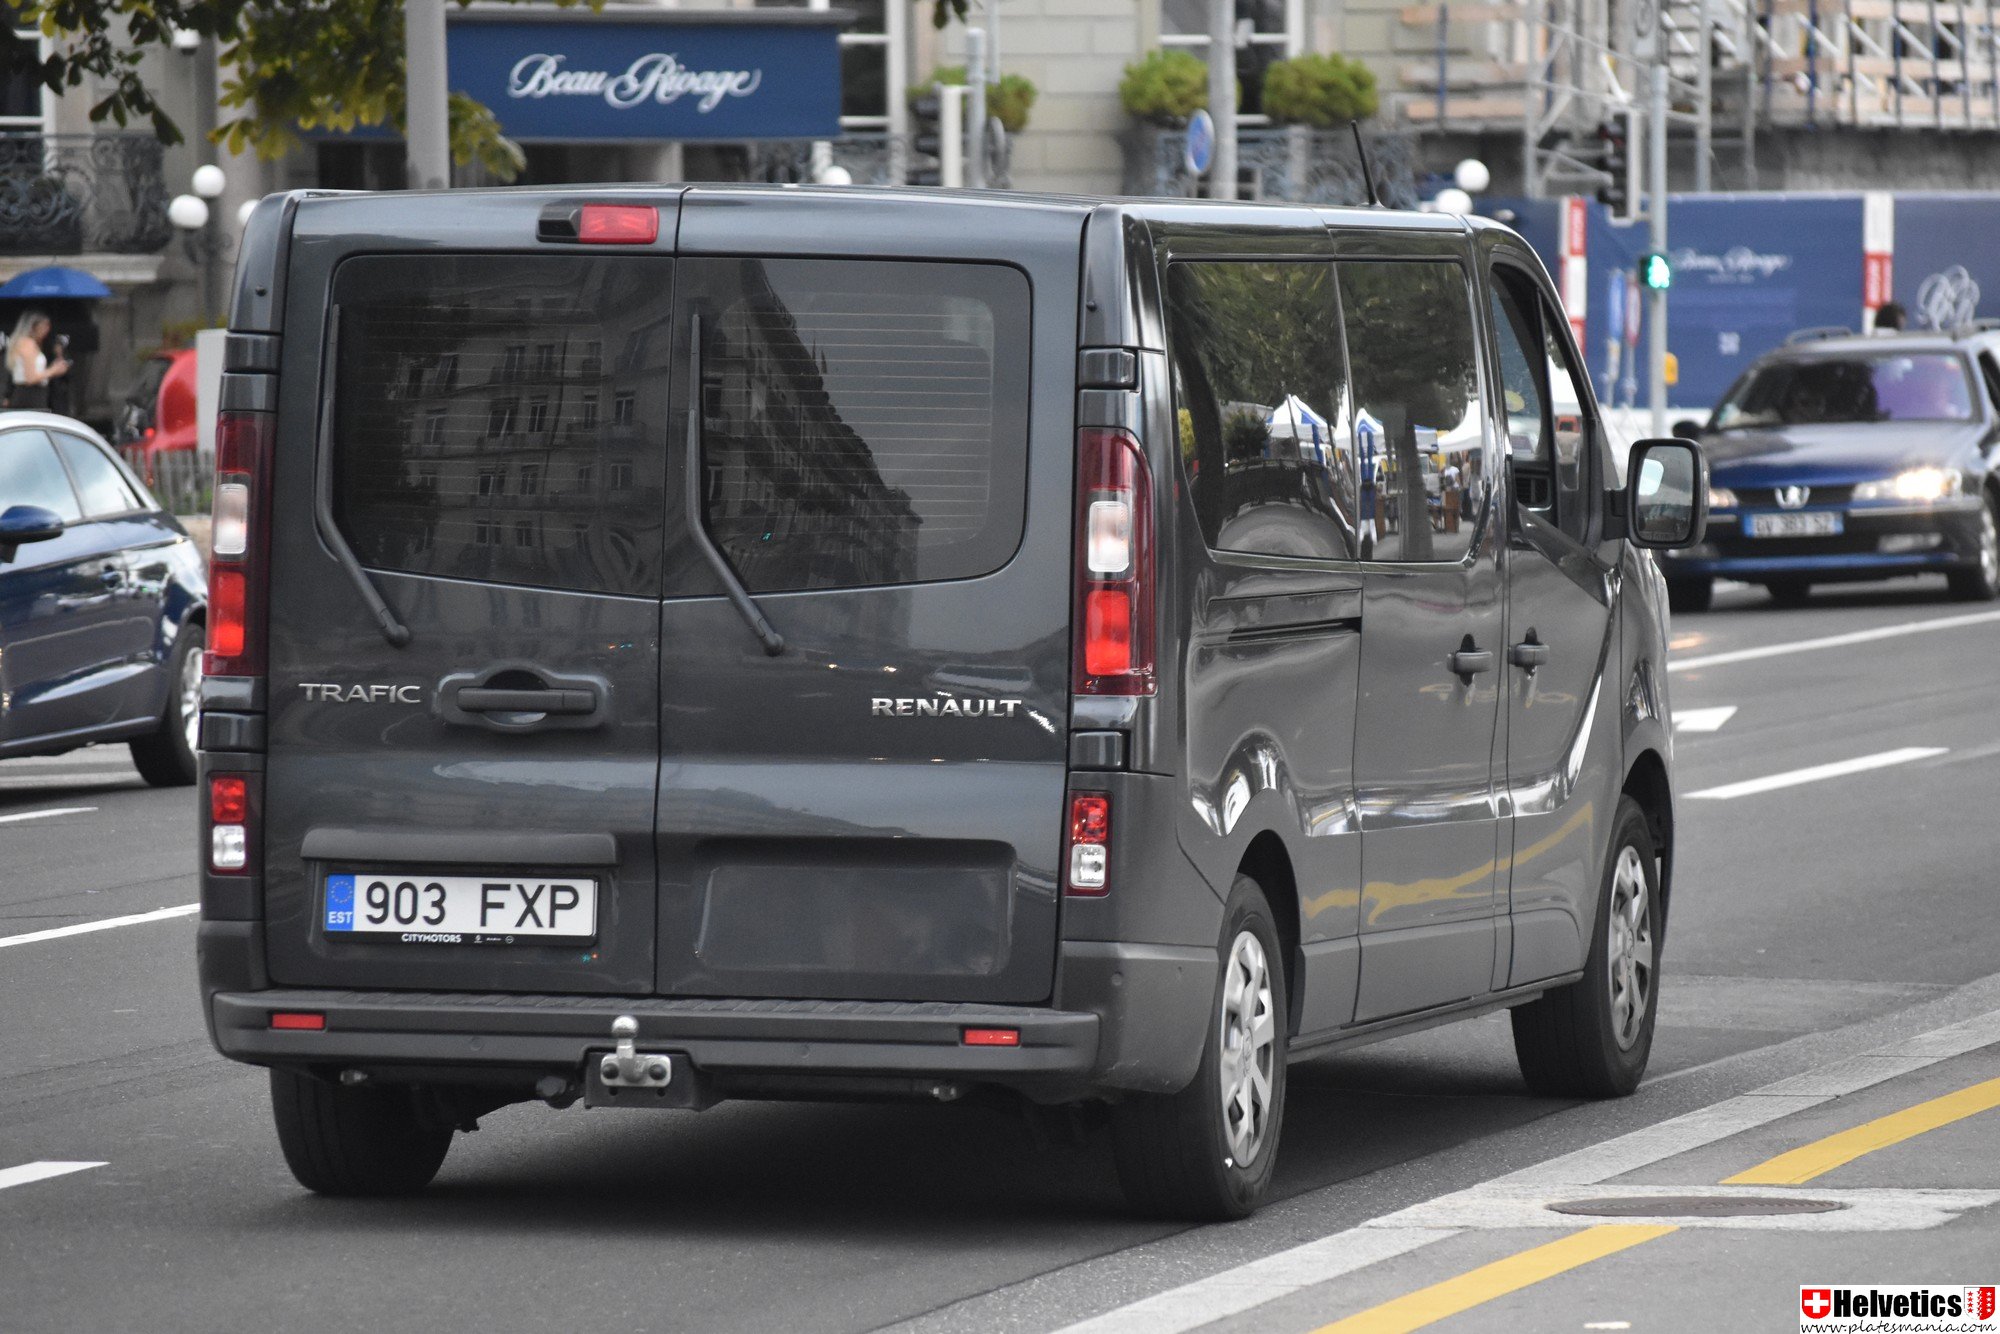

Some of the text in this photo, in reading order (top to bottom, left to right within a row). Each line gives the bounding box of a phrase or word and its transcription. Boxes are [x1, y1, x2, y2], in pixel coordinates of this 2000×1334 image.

[507, 53, 762, 113] Beau Rivage
[298, 683, 421, 703] TRAFIC
[871, 698, 1022, 718] RENAULT
[366, 881, 579, 928] 903 FXP
[328, 911, 353, 924] EST
[401, 933, 462, 943] CITYMOTORS
